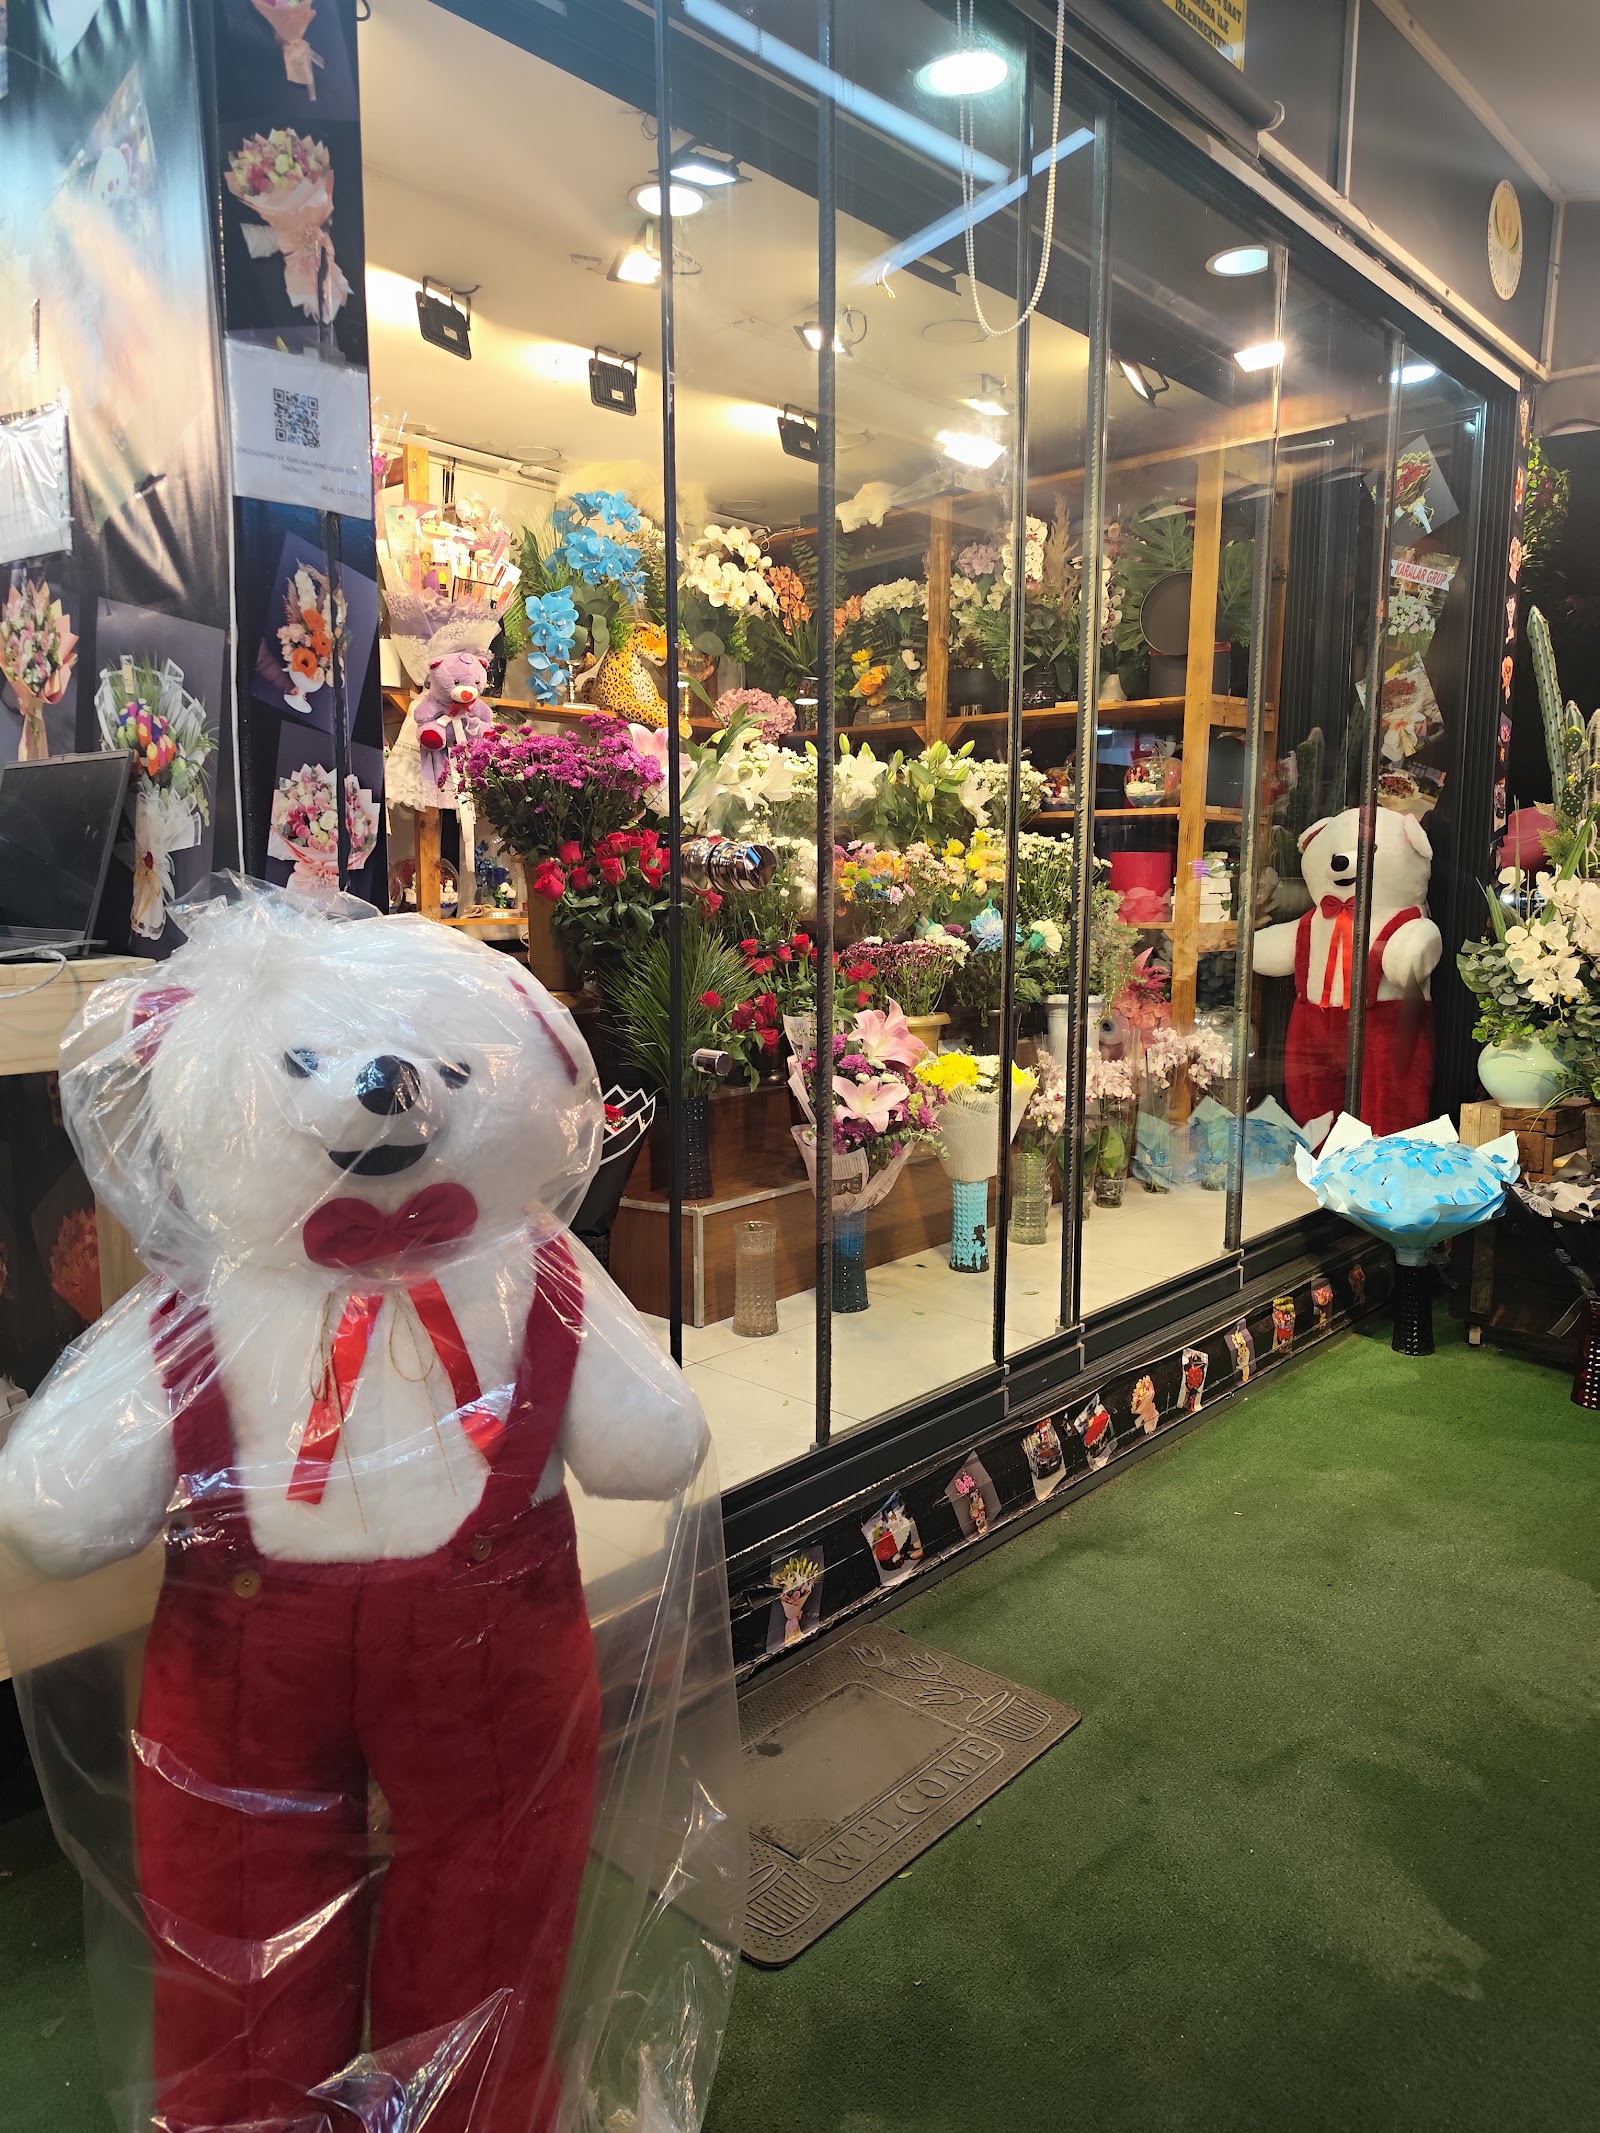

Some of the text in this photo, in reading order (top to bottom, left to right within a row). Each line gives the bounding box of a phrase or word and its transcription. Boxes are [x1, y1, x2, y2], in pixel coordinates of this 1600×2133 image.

[1223, 0, 1242, 24] SAAT
[1395, 562, 1448, 586] KARALAR GRUP
[814, 1741, 997, 1870] WELCOME
